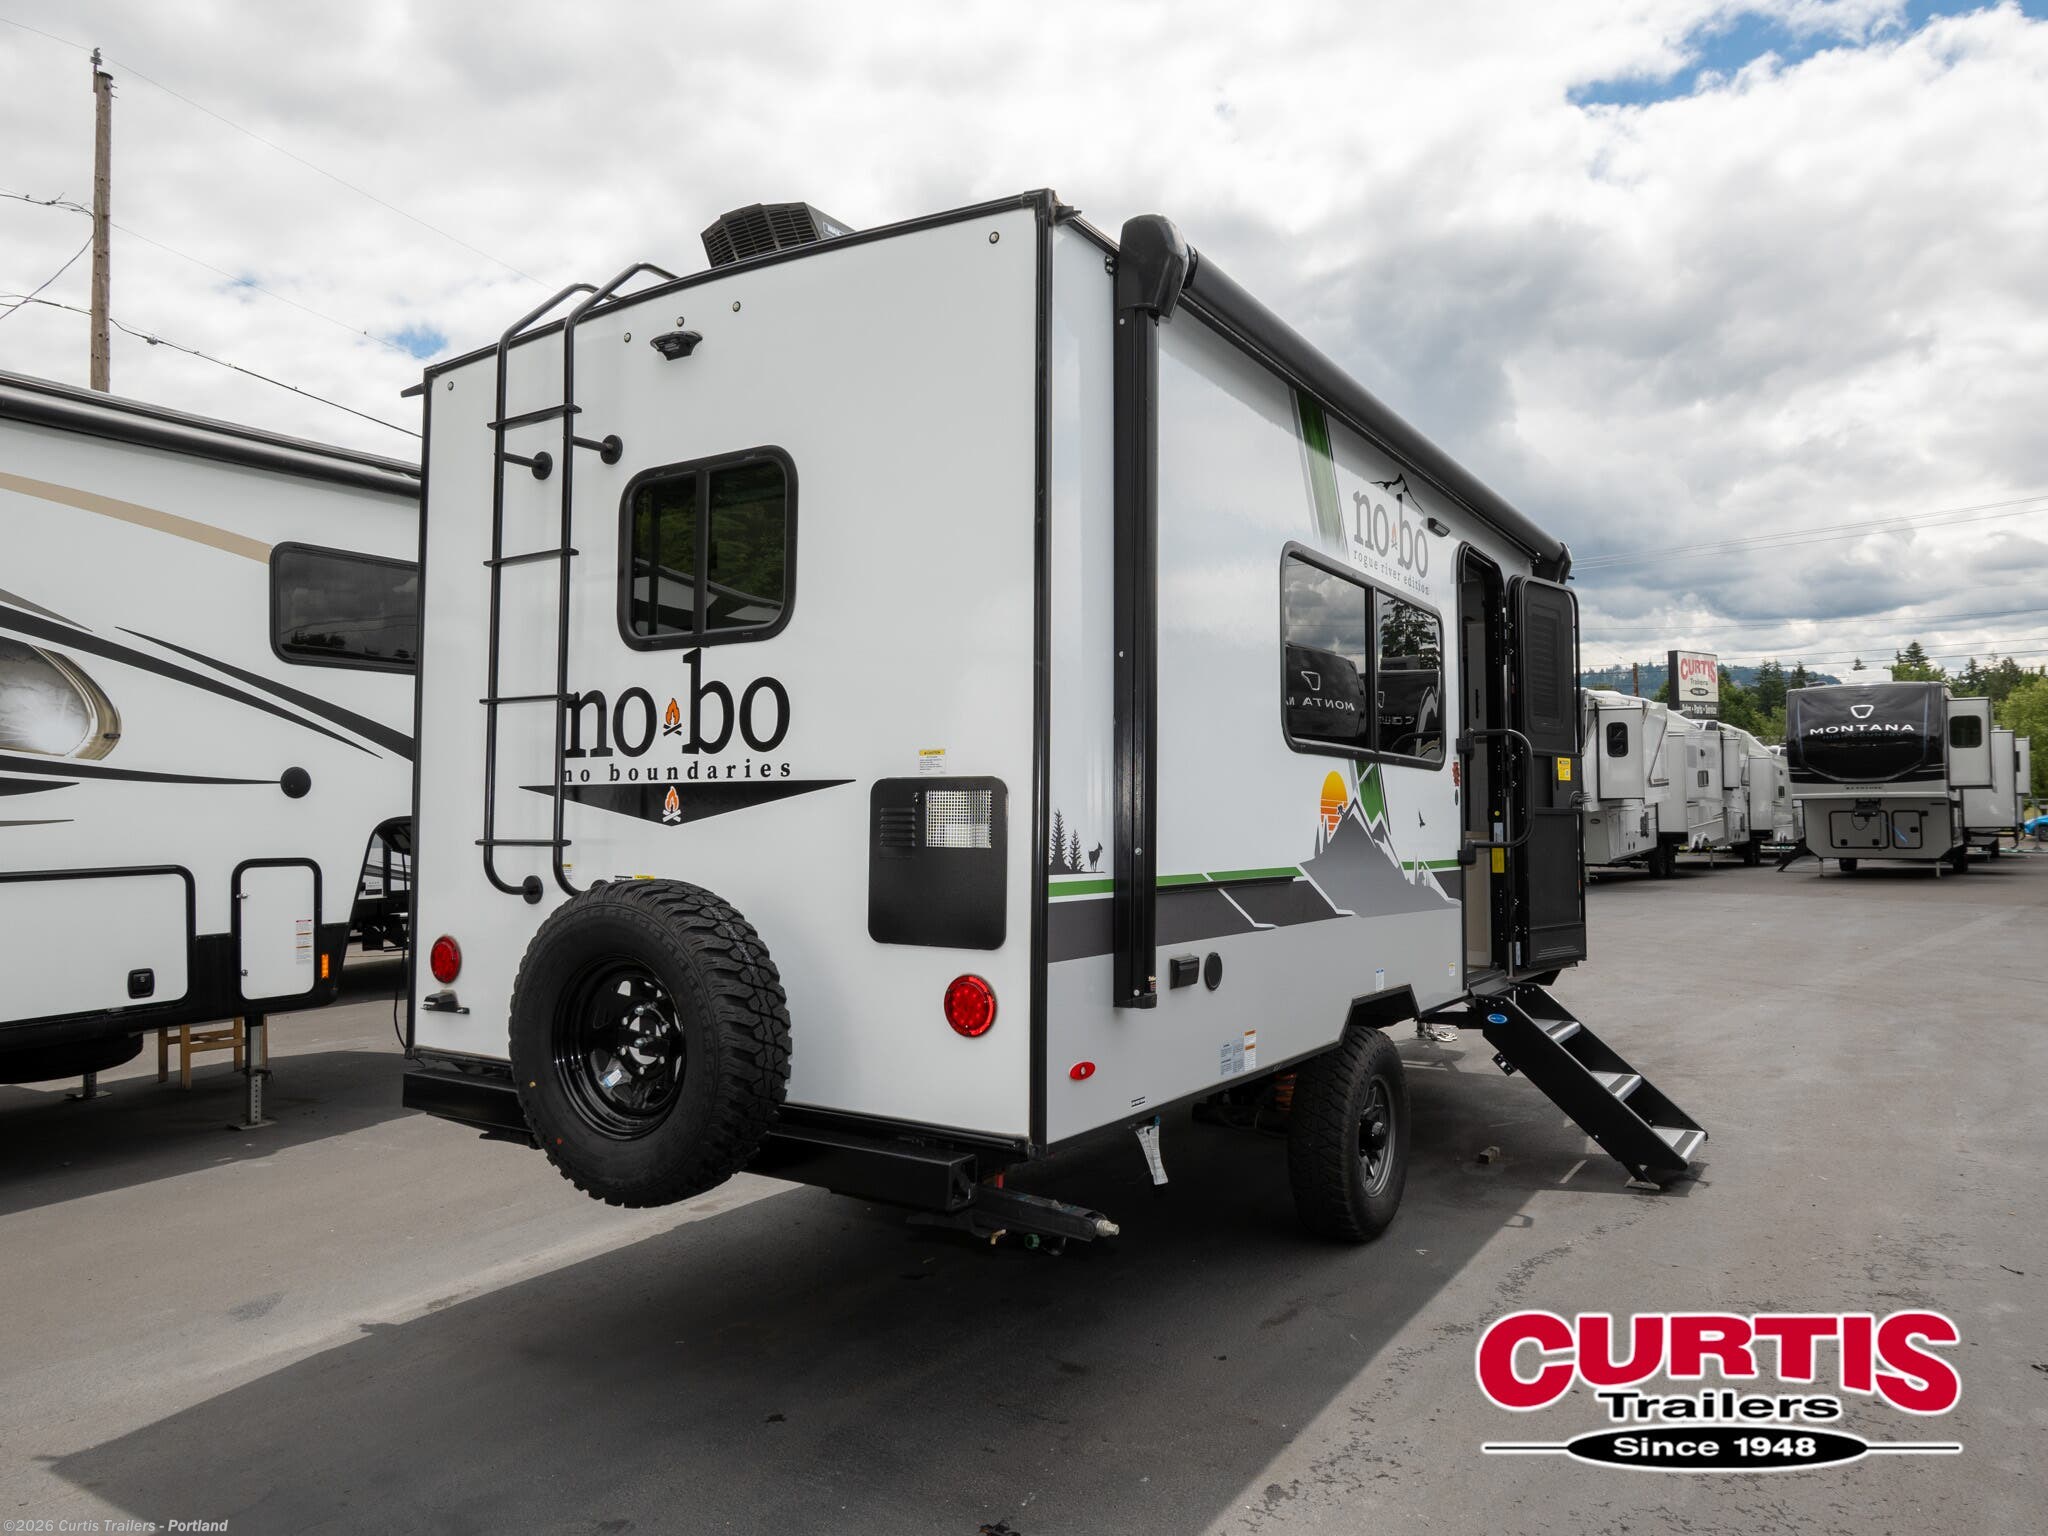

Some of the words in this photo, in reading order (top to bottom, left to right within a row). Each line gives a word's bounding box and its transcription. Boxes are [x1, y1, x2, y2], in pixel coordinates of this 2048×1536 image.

[1354, 550, 1378, 570] rogue
[1381, 562, 1400, 581] river
[1404, 575, 1430, 595] edition
[1681, 658, 1716, 683] CURTIS
[1810, 724, 1915, 735] MONTANA
[563, 768, 591, 783] no
[608, 758, 791, 782] boundaries
